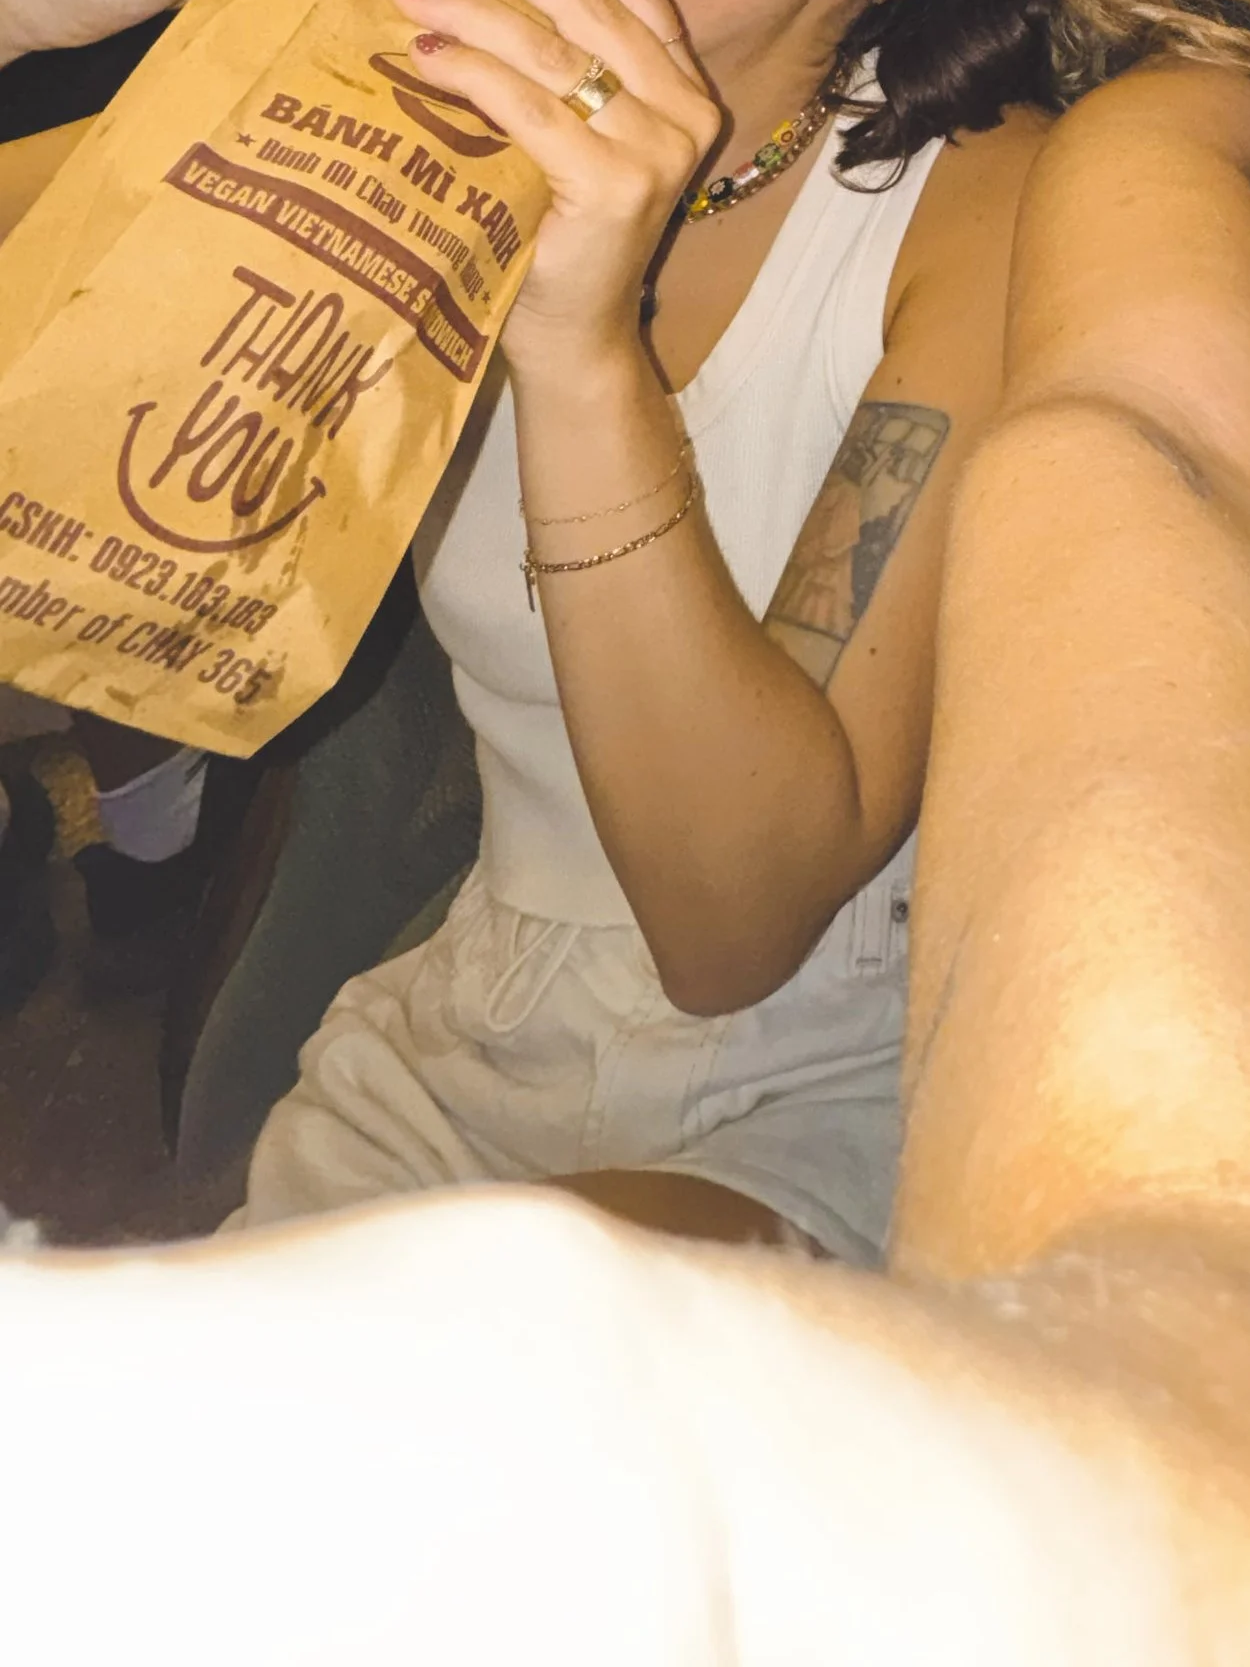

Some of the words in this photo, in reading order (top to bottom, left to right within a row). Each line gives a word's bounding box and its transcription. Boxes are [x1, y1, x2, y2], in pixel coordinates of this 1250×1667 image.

[183, 161, 276, 214] VEGAN
[276, 200, 418, 303] VIETNAMESE
[260, 93, 403, 163] BÁNH
[400, 145, 456, 203] MÌ
[456, 186, 522, 273] XANH
[356, 176, 407, 224] Chay
[200, 265, 394, 441] THANK
[150, 381, 293, 518] YOU
[77, 612, 133, 644] of
[116, 621, 214, 673] CHAY
[198, 648, 272, 705] 365
